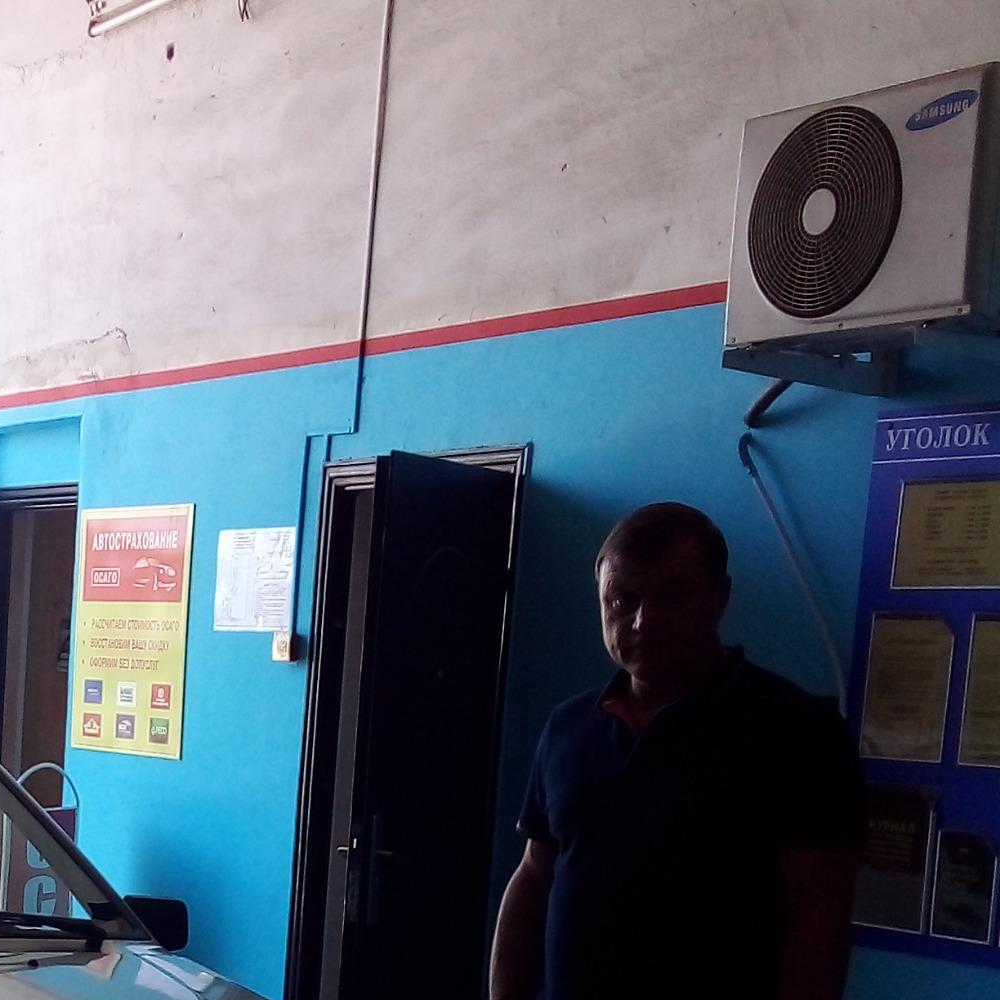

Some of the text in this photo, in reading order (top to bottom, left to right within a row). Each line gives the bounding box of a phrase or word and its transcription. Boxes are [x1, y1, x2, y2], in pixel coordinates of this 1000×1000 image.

[914, 99, 970, 121] SAMSUNG
[886, 423, 990, 451] УГОЛОК
[92, 530, 178, 551] АВТОСТРАХОВАНИЕ
[93, 571, 118, 584] ОСАГО
